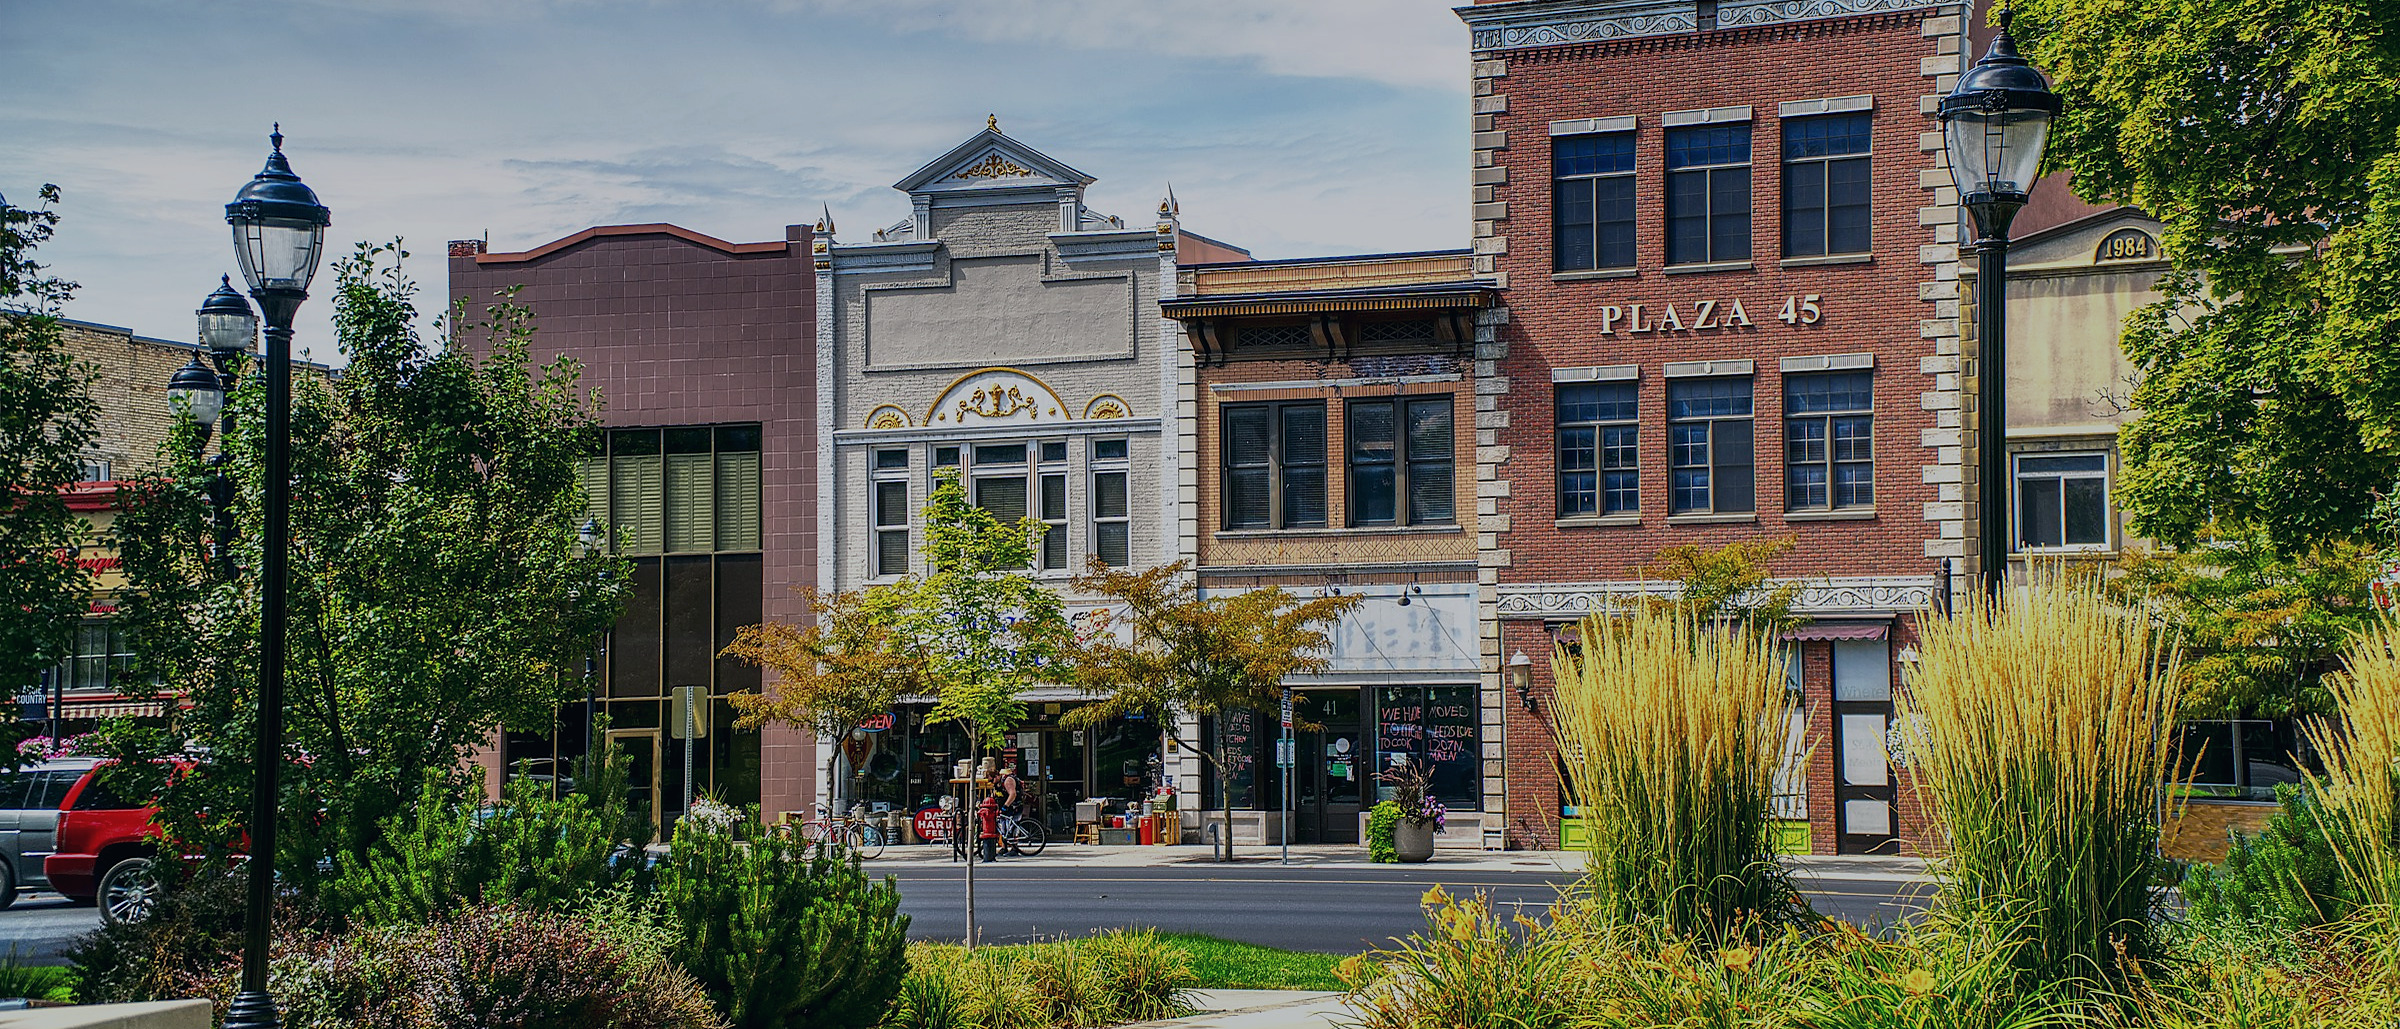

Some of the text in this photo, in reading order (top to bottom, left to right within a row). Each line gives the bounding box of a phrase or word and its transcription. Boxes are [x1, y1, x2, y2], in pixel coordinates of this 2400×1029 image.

[2105, 236, 2147, 258] 1984
[1599, 293, 1821, 335] PLAZA 45
[16, 694, 47, 705] COUNTRY
[1839, 685, 1885, 699] Where
[1322, 700, 1337, 715] 41
[1381, 705, 1469, 721] WE HAVE MOVED
[859, 714, 893, 729] OPEN
[1231, 712, 1251, 724] AVE
[1380, 722, 1400, 736] TO
[1427, 724, 1456, 738] NEEDS
[1456, 725, 1474, 738] LOVE
[1379, 737, 1465, 752] TO COOK 1207 N.
[1429, 749, 1457, 761] MAIN
[917, 820, 953, 829] HARU
